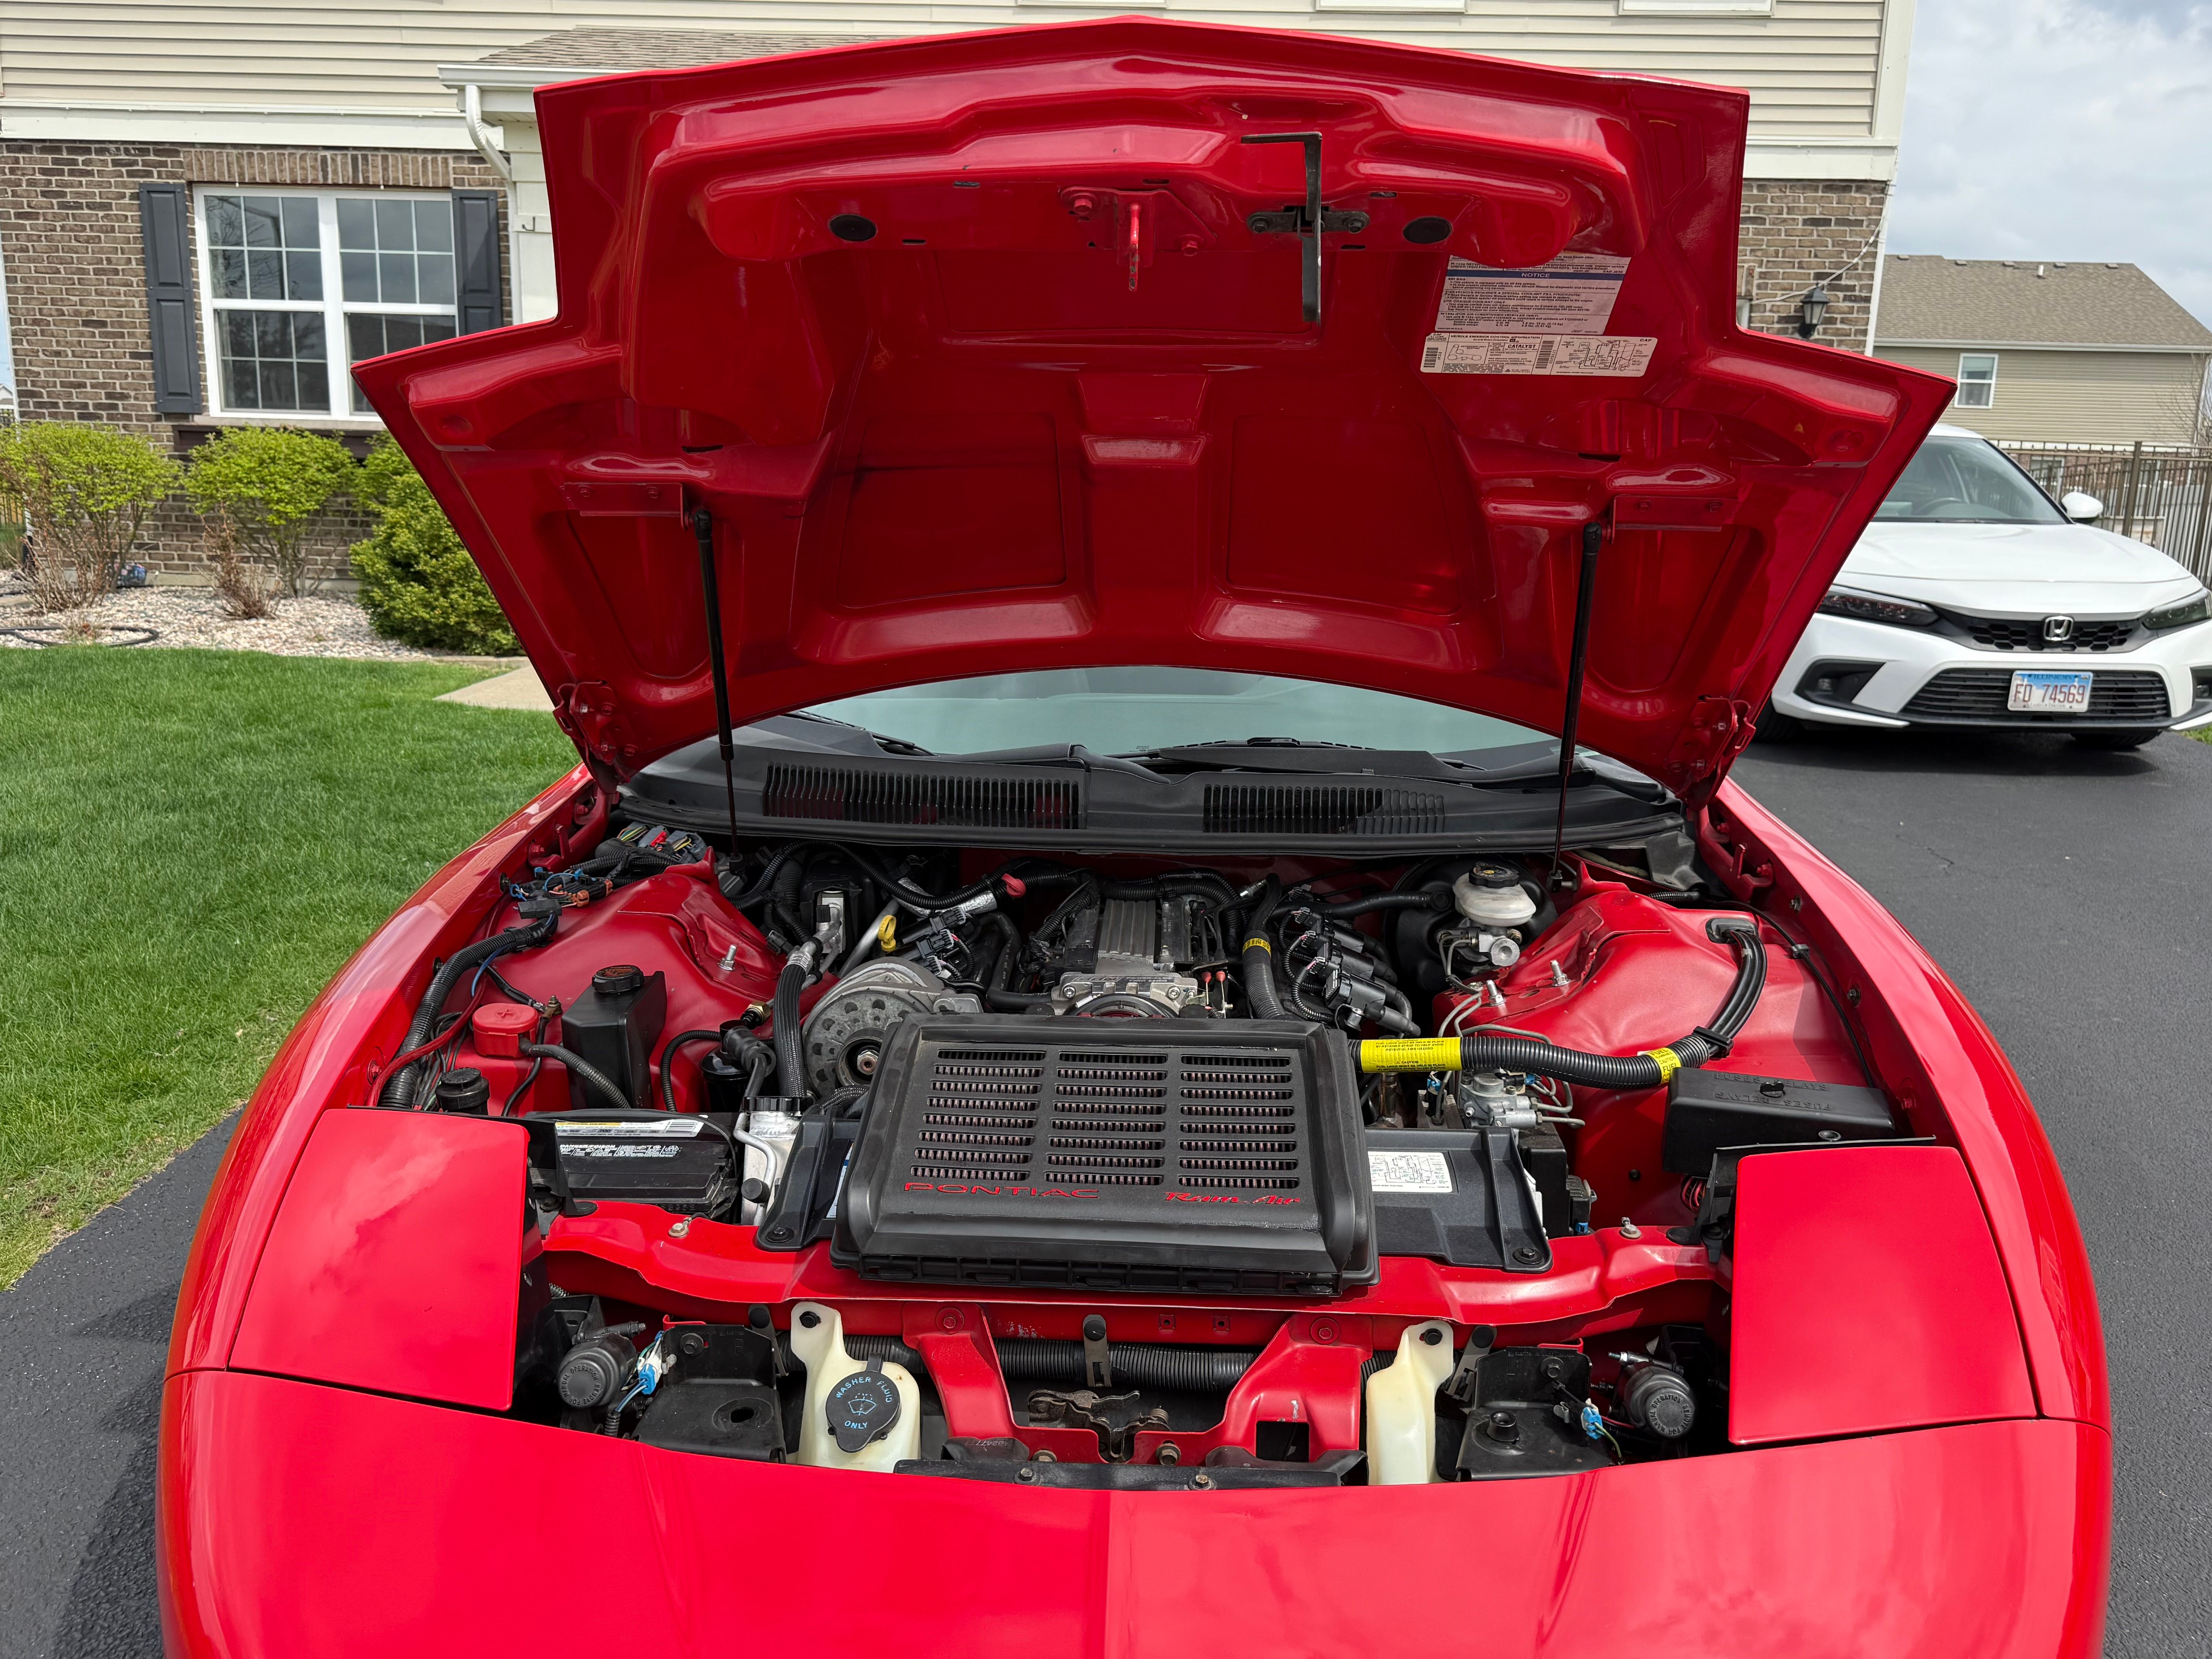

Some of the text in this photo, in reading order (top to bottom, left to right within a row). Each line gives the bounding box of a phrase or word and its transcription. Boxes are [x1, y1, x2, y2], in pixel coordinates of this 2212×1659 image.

[2042, 684, 2086, 703] 74569
[1662, 1063, 1676, 1073] FUEL
[1714, 1073, 1760, 1084] FUSES
[1715, 1091, 1830, 1111] FUSES RELAYS
[904, 1182, 1099, 1198] PONTIAC
[1164, 1192, 1301, 1204] Ram Air
[561, 1365, 600, 1405] REMOVE FOR MANUAL OPERATION
[836, 1376, 893, 1403] WASHER FLUID
[1651, 1394, 1683, 1408] OPERATION
[844, 1420, 868, 1429] ONLY
[1650, 1410, 1665, 1432] MANUAL
[1681, 1404, 1691, 1430] REMOVE
